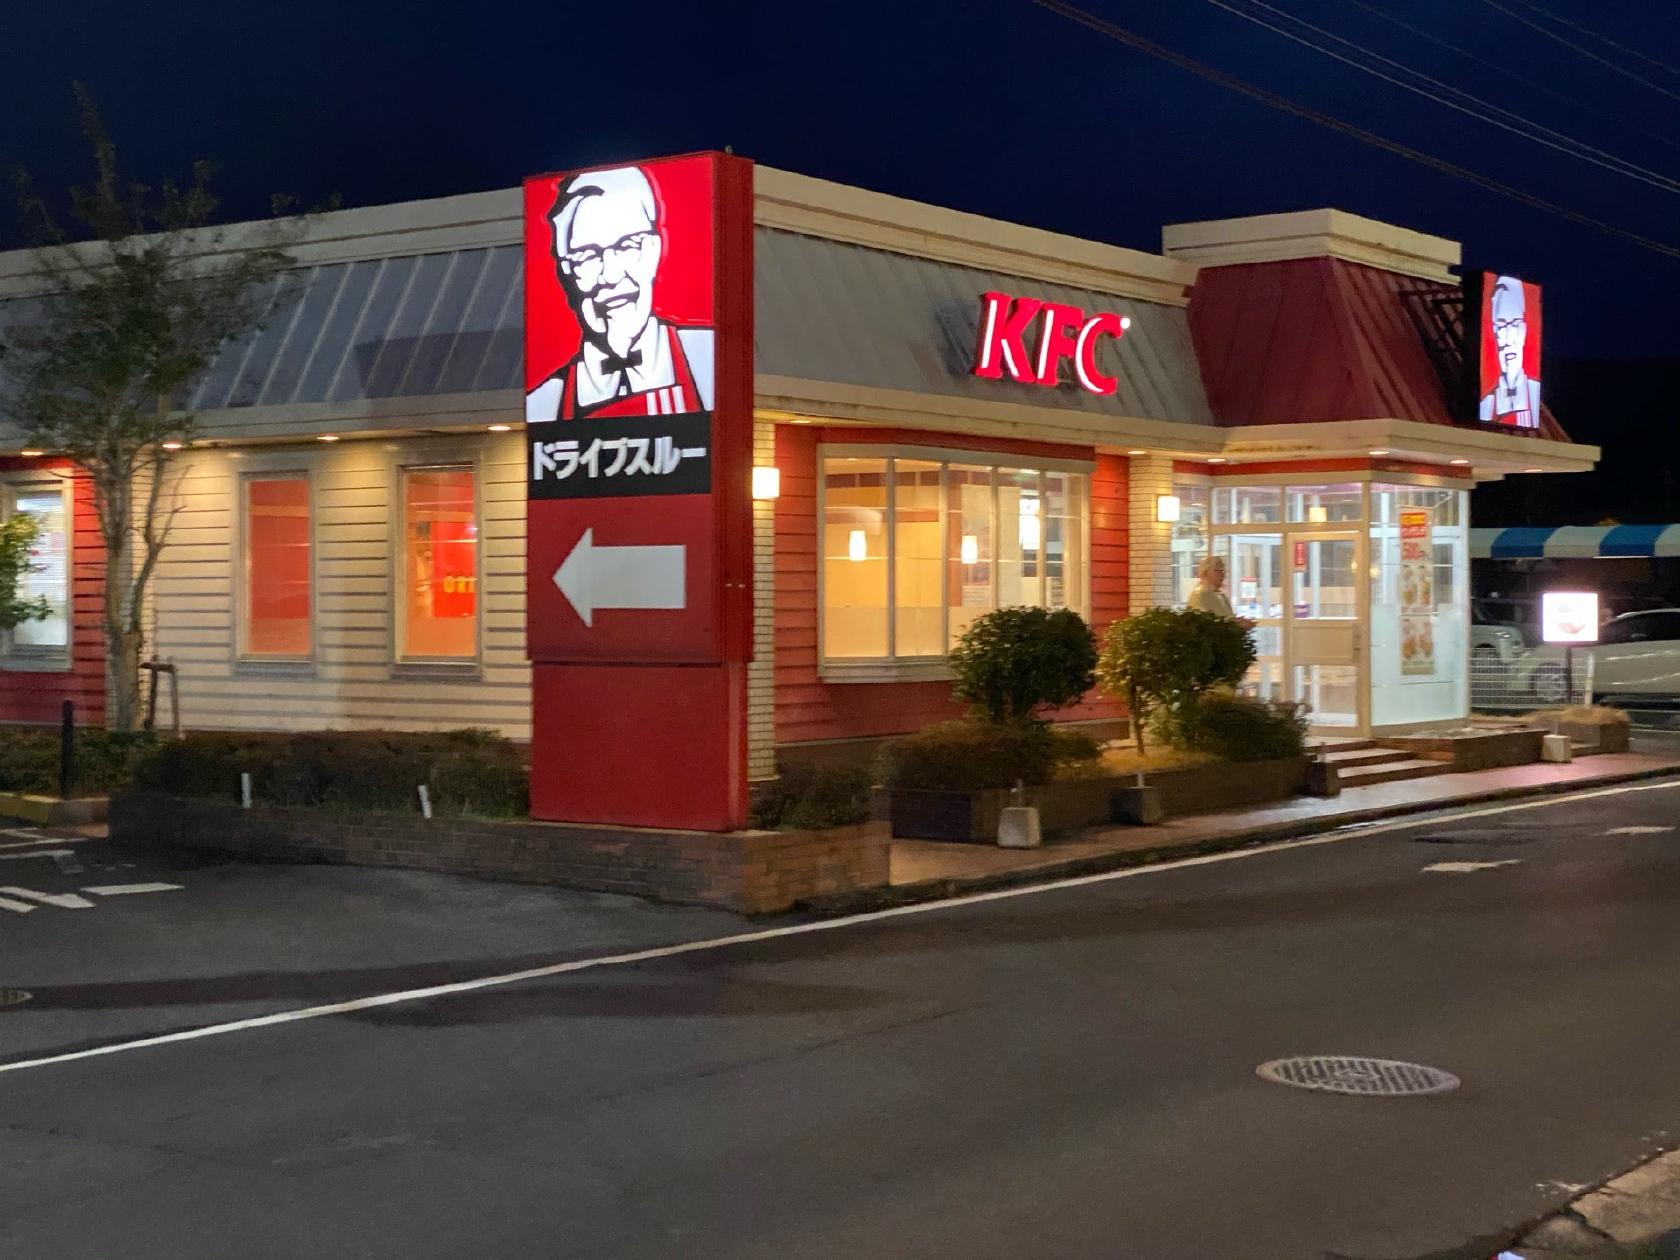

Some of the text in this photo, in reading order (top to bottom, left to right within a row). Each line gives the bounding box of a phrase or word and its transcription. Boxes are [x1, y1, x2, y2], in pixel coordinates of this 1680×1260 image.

[973, 291, 1123, 396] KFC
[533, 436, 707, 481] ドライブスルー
